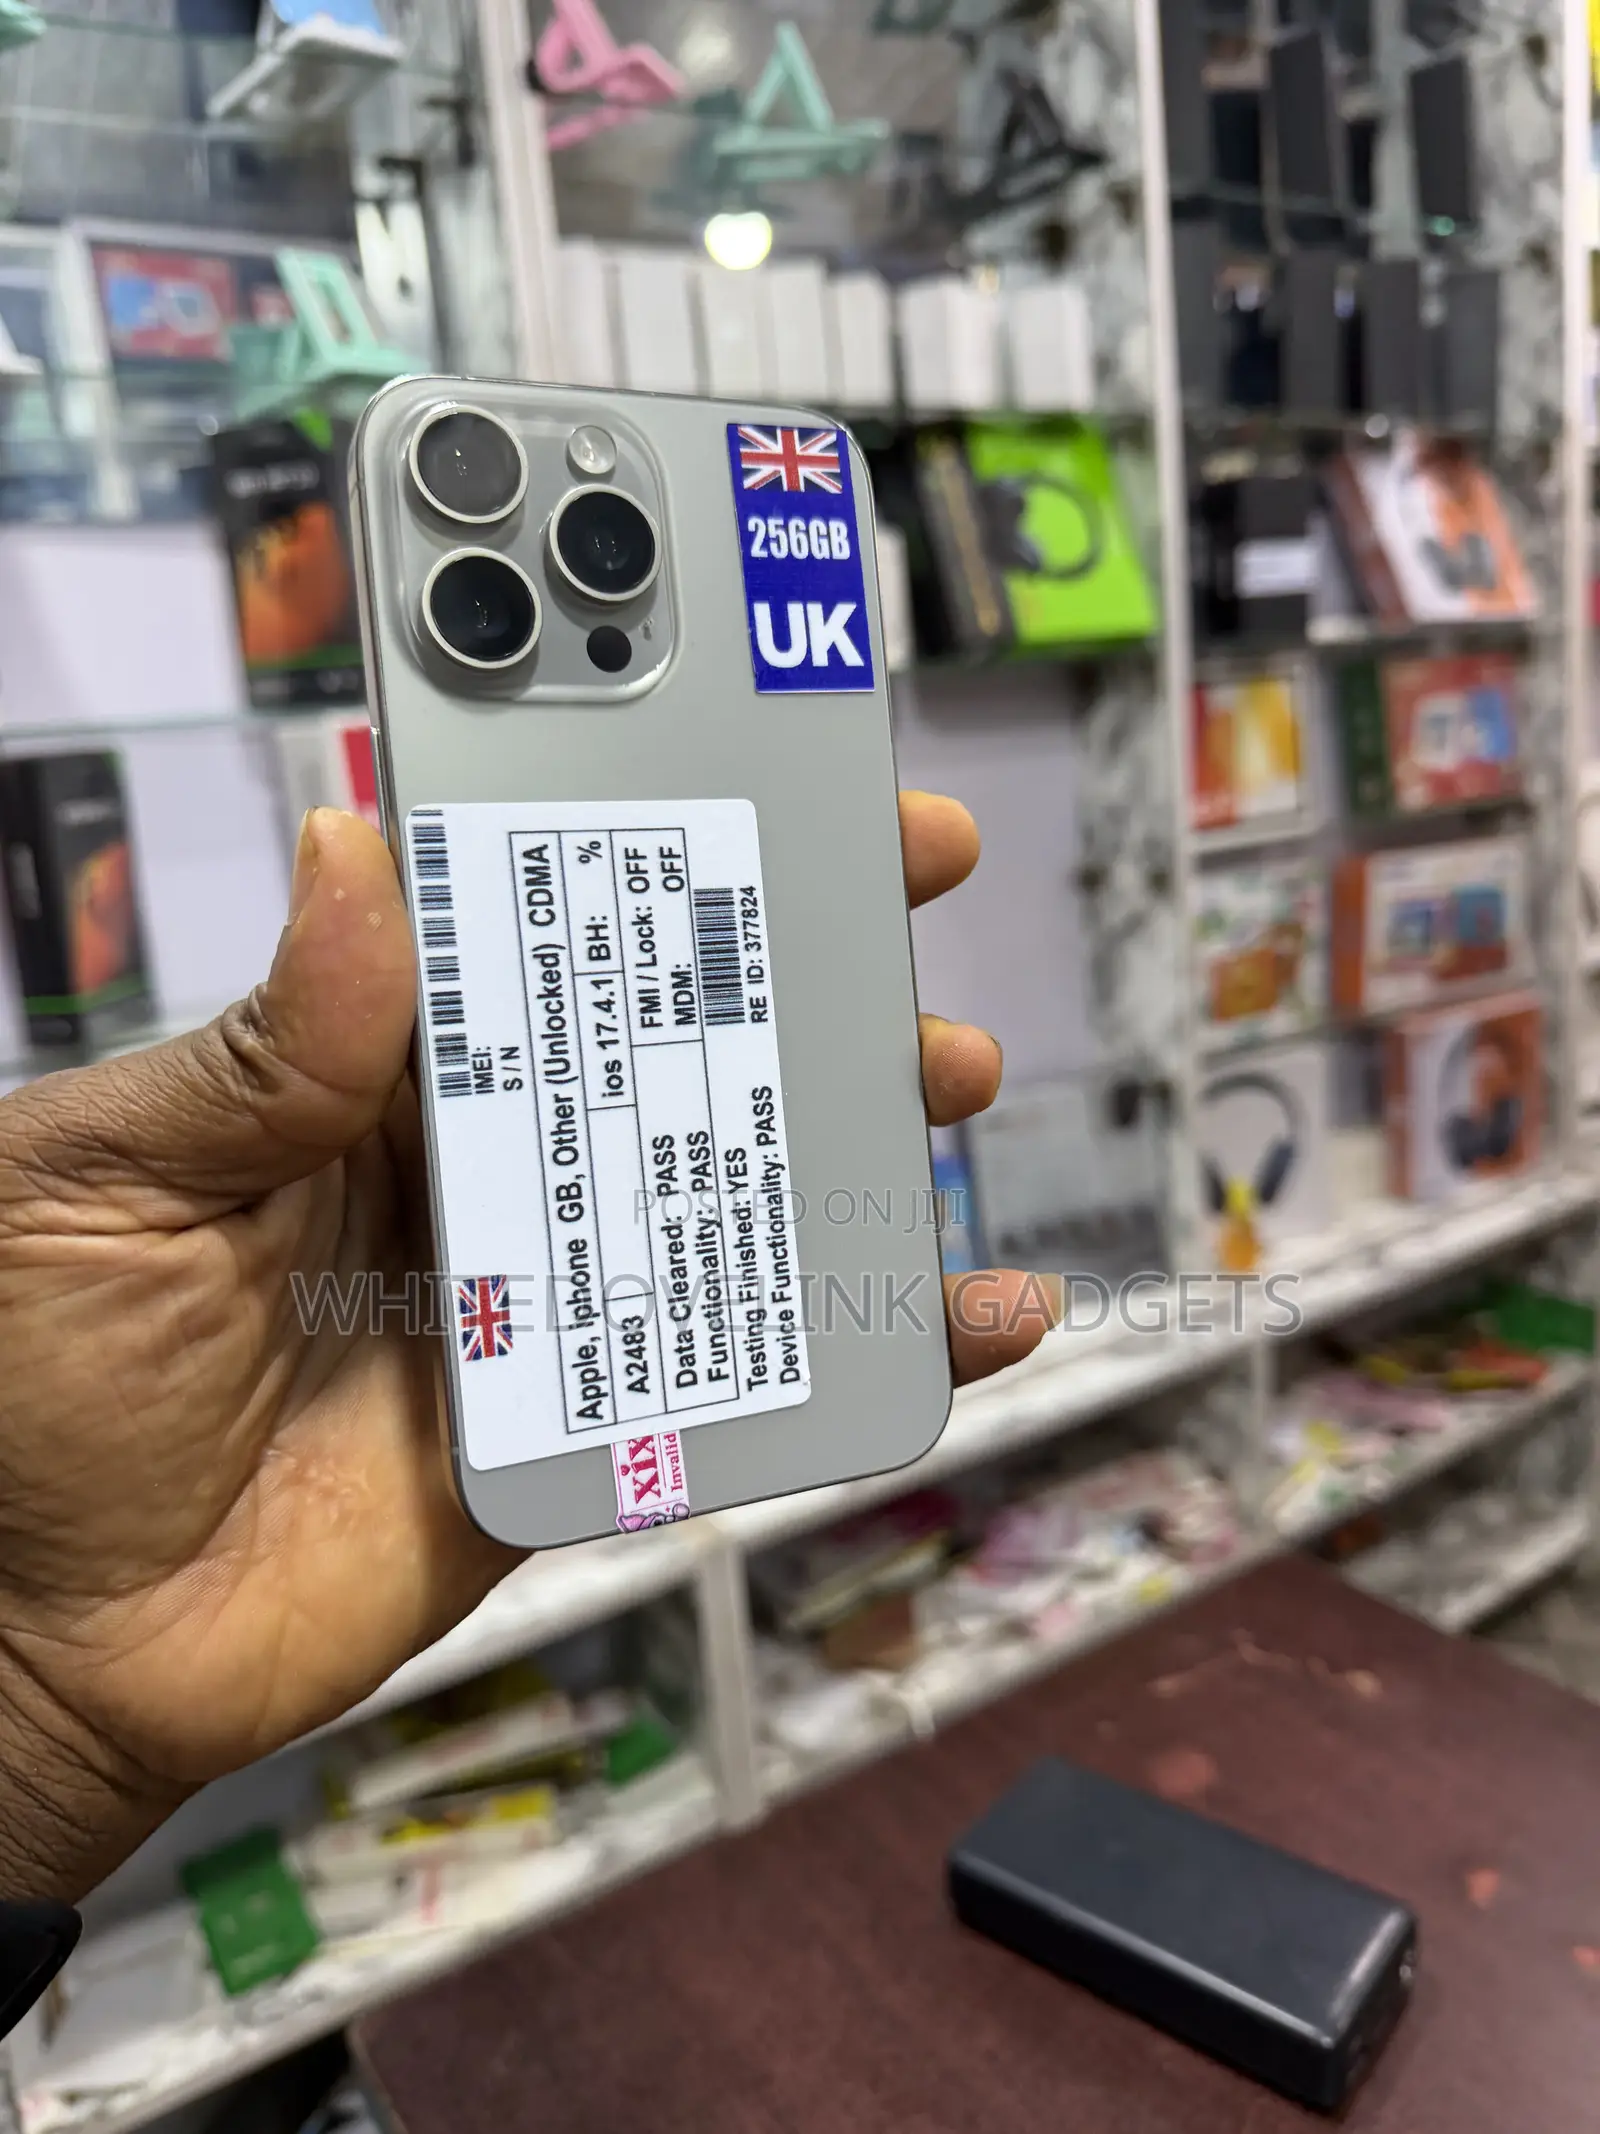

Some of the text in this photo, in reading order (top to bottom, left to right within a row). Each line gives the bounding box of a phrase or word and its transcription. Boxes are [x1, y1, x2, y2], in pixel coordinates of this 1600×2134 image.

[748, 517, 850, 560] 256GB
[753, 602, 864, 668] UK
[578, 840, 611, 962] BH: %
[624, 847, 650, 894] OFF
[632, 906, 658, 969] Lock:
[659, 846, 697, 1026] MDM: OFF
[739, 885, 768, 1023] RE ID: 377824
[591, 978, 624, 1098] ios 17.4.1
[638, 988, 663, 1030] FMI
[473, 1046, 495, 1095] IMEI:
[523, 843, 608, 1420] Apple, iphone GB, Other (Unlocked) CDMA
[652, 1134, 698, 1388] Data Cleared: PASS
[687, 1130, 729, 1383] Functionality: PASS
[725, 1147, 767, 1391] Testing Finished: YES
[751, 1085, 800, 1384] Device Functionality: PASS
[622, 1315, 650, 1394] A2483
[664, 1432, 683, 1492] Invalid
